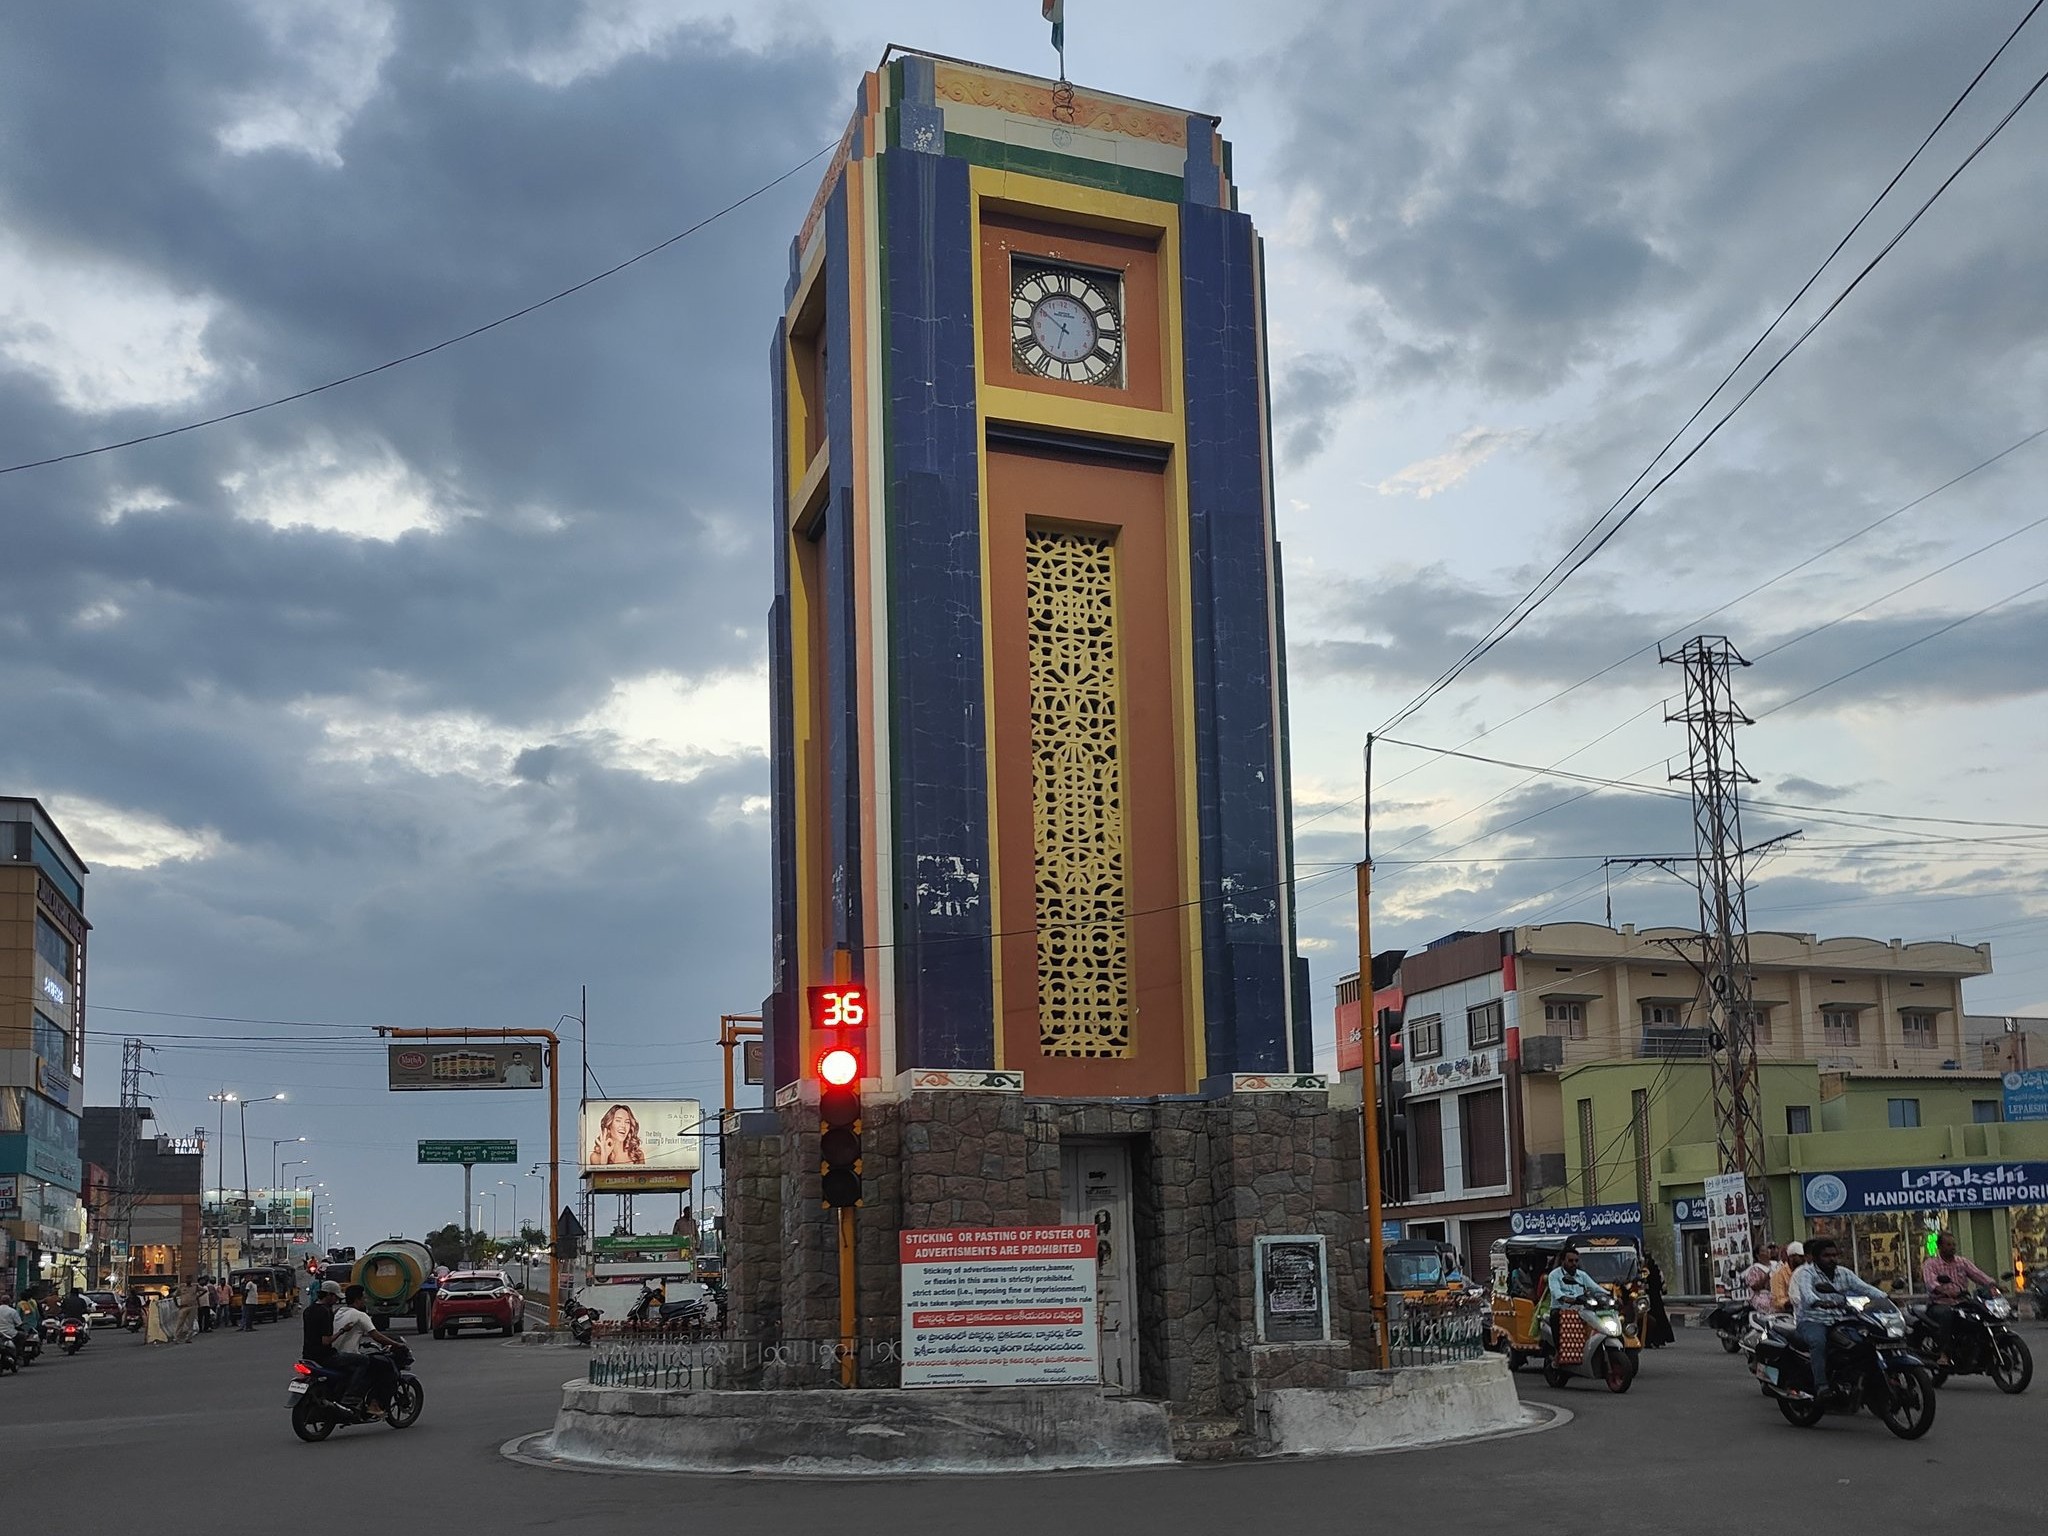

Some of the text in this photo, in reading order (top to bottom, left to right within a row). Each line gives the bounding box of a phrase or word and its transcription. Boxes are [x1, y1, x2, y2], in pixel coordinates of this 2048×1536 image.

[1048, 302, 1056, 310] 11
[823, 992, 864, 1025] 36
[1864, 1184, 2048, 1206] HANDICRAFTS EMPORI
[905, 1228, 1092, 1245] STICKING OR PASTING OF POSTER OR
[915, 1243, 1083, 1258] ADVERTISMENTS ARE PROHIBITED
[923, 1266, 953, 1276] Sticking
[953, 1266, 962, 1274] of
[962, 1264, 1019, 1274] advertisements
[966, 1276, 981, 1284] this
[1008, 1275, 1034, 1284] strictly
[1035, 1274, 1075, 1284] prohibited.
[912, 1289, 932, 1297] strict
[932, 1288, 957, 1296] action
[974, 1286, 1007, 1296] imposing
[1008, 1286, 1023, 1294] fine
[907, 1300, 920, 1308] will
[929, 1299, 949, 1307] taken
[949, 1299, 974, 1308] against
[974, 1299, 999, 1307] anyone
[1035, 1297, 1064, 1305] violating
[946, 1313, 965, 1322] లేదా
[916, 1333, 927, 1342] ఈ
[1065, 1328, 1083, 1338] లేదా
